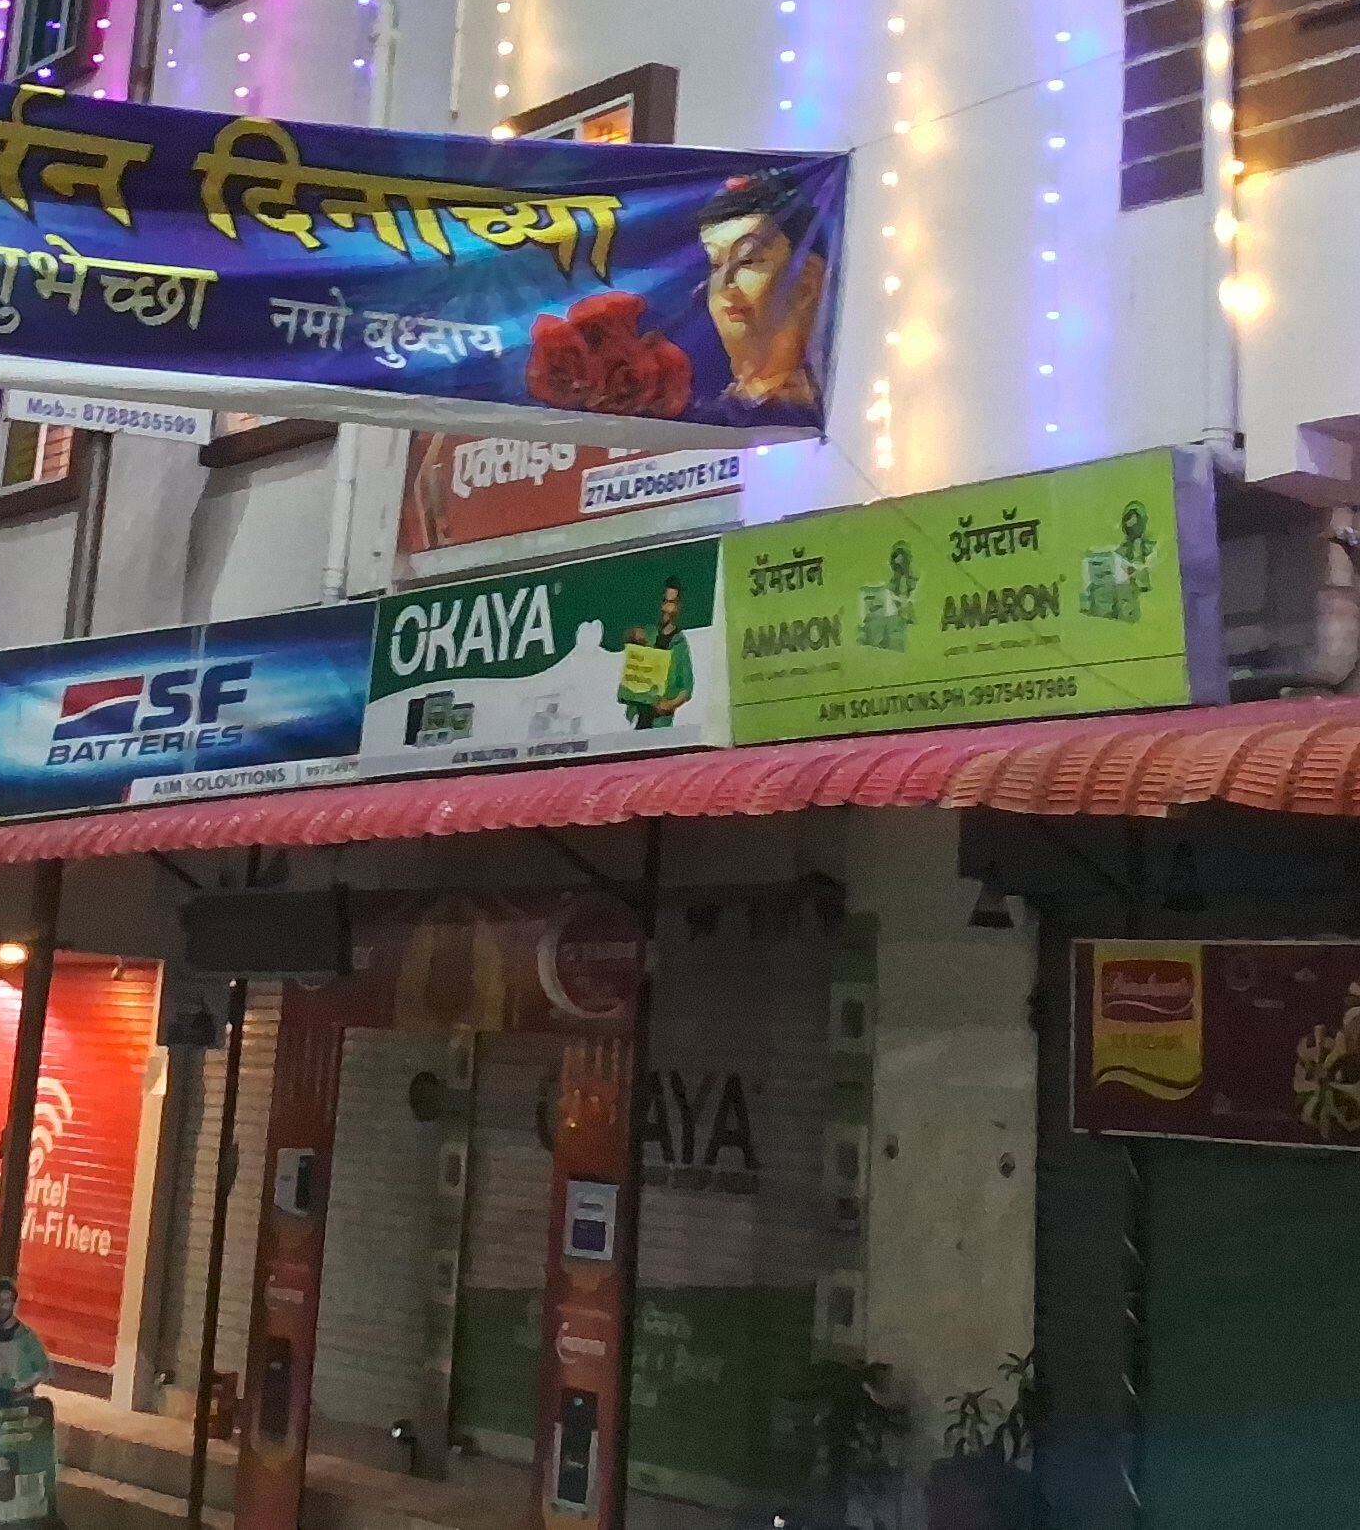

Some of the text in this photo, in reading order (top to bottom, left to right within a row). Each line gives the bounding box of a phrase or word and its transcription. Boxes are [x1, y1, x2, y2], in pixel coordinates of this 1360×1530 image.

[193, 116, 622, 281] दिनाच्या
[269, 286, 353, 352] नमो
[390, 583, 555, 677] OKAYA
[941, 582, 1062, 631] AMARON
[742, 614, 841, 659] AMARON
[141, 661, 254, 732] SF
[46, 725, 245, 767] BATTERIES
[24, 1172, 71, 1209] irtel
[65, 1213, 112, 1257] here
